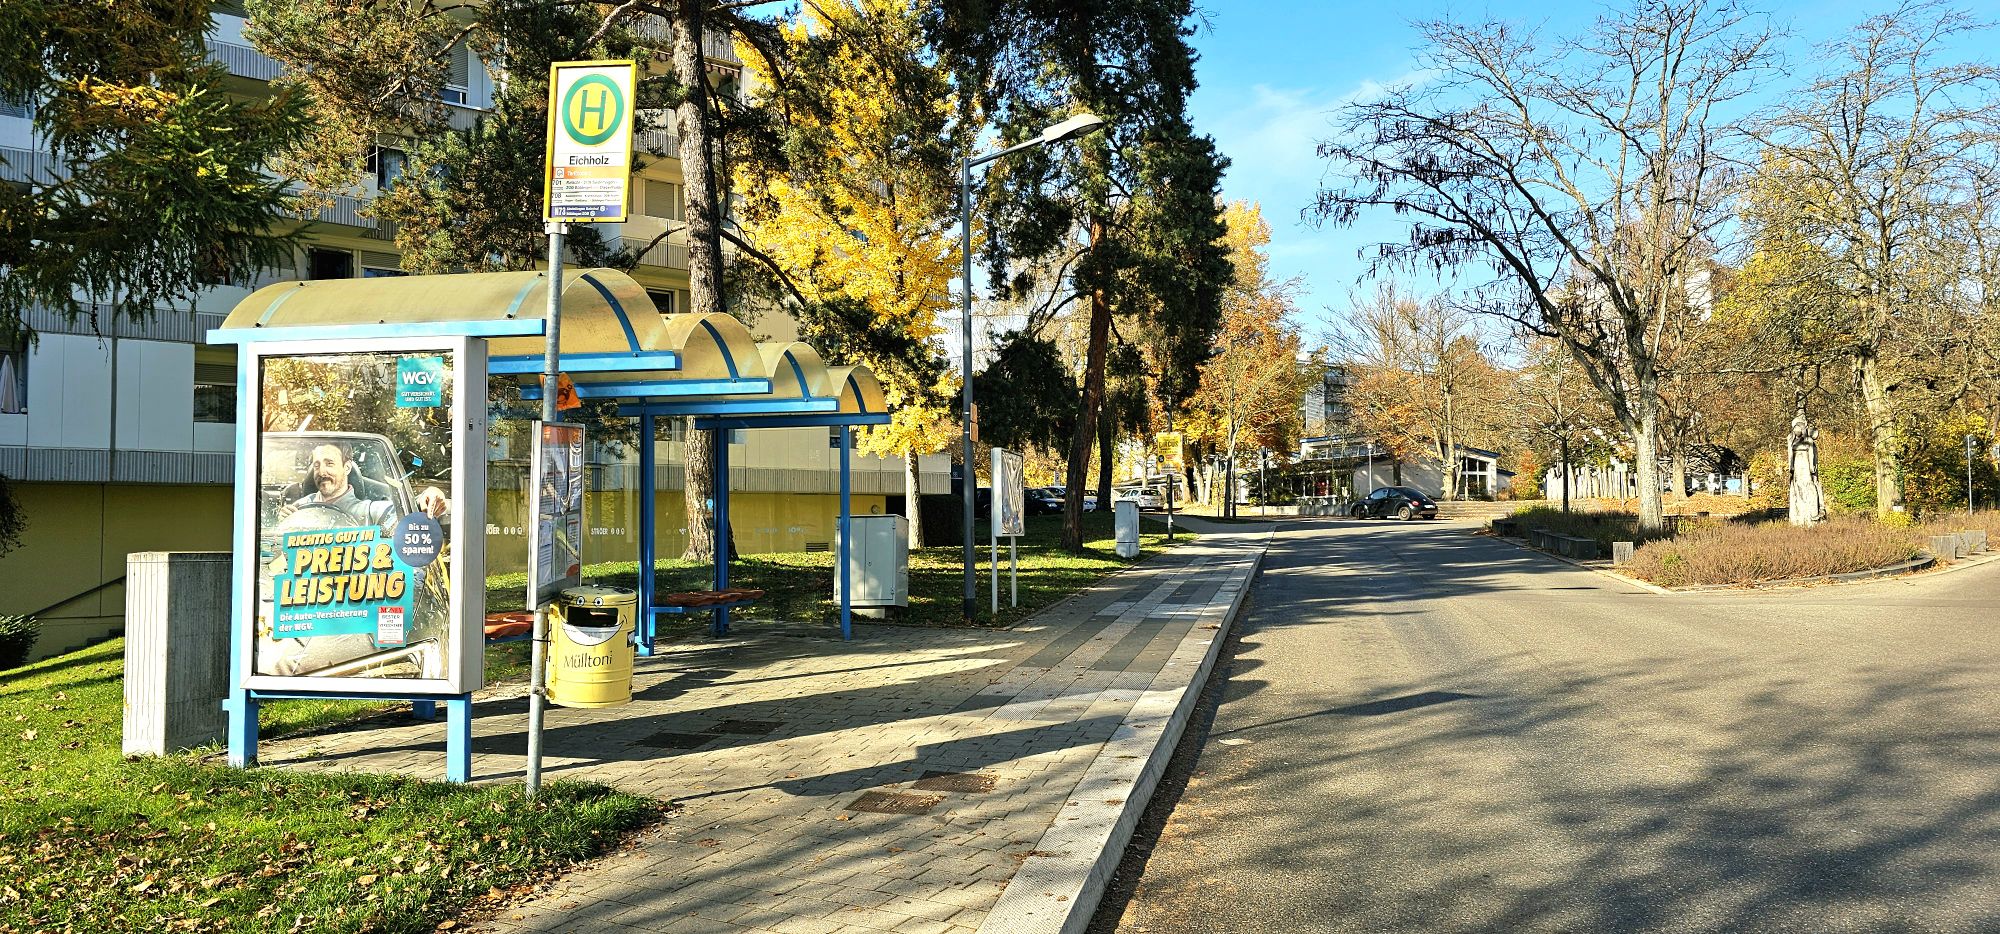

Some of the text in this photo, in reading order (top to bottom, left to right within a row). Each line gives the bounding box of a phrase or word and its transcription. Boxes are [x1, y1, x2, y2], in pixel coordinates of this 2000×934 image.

[579, 90, 607, 130] H
[569, 156, 610, 166] Eichholz
[402, 371, 436, 385] WGV
[408, 523, 420, 531] Bis
[288, 530, 375, 547] RICHTIG GUT IN
[405, 533, 432, 545] 50 %
[402, 546, 434, 555] sparen!
[295, 543, 394, 576] PREIS &
[281, 572, 405, 607] LEISTUNG
[280, 609, 368, 622] Die Auto-Versicherung
[279, 622, 314, 632] der WGV.
[563, 650, 613, 669] Mülltoni
